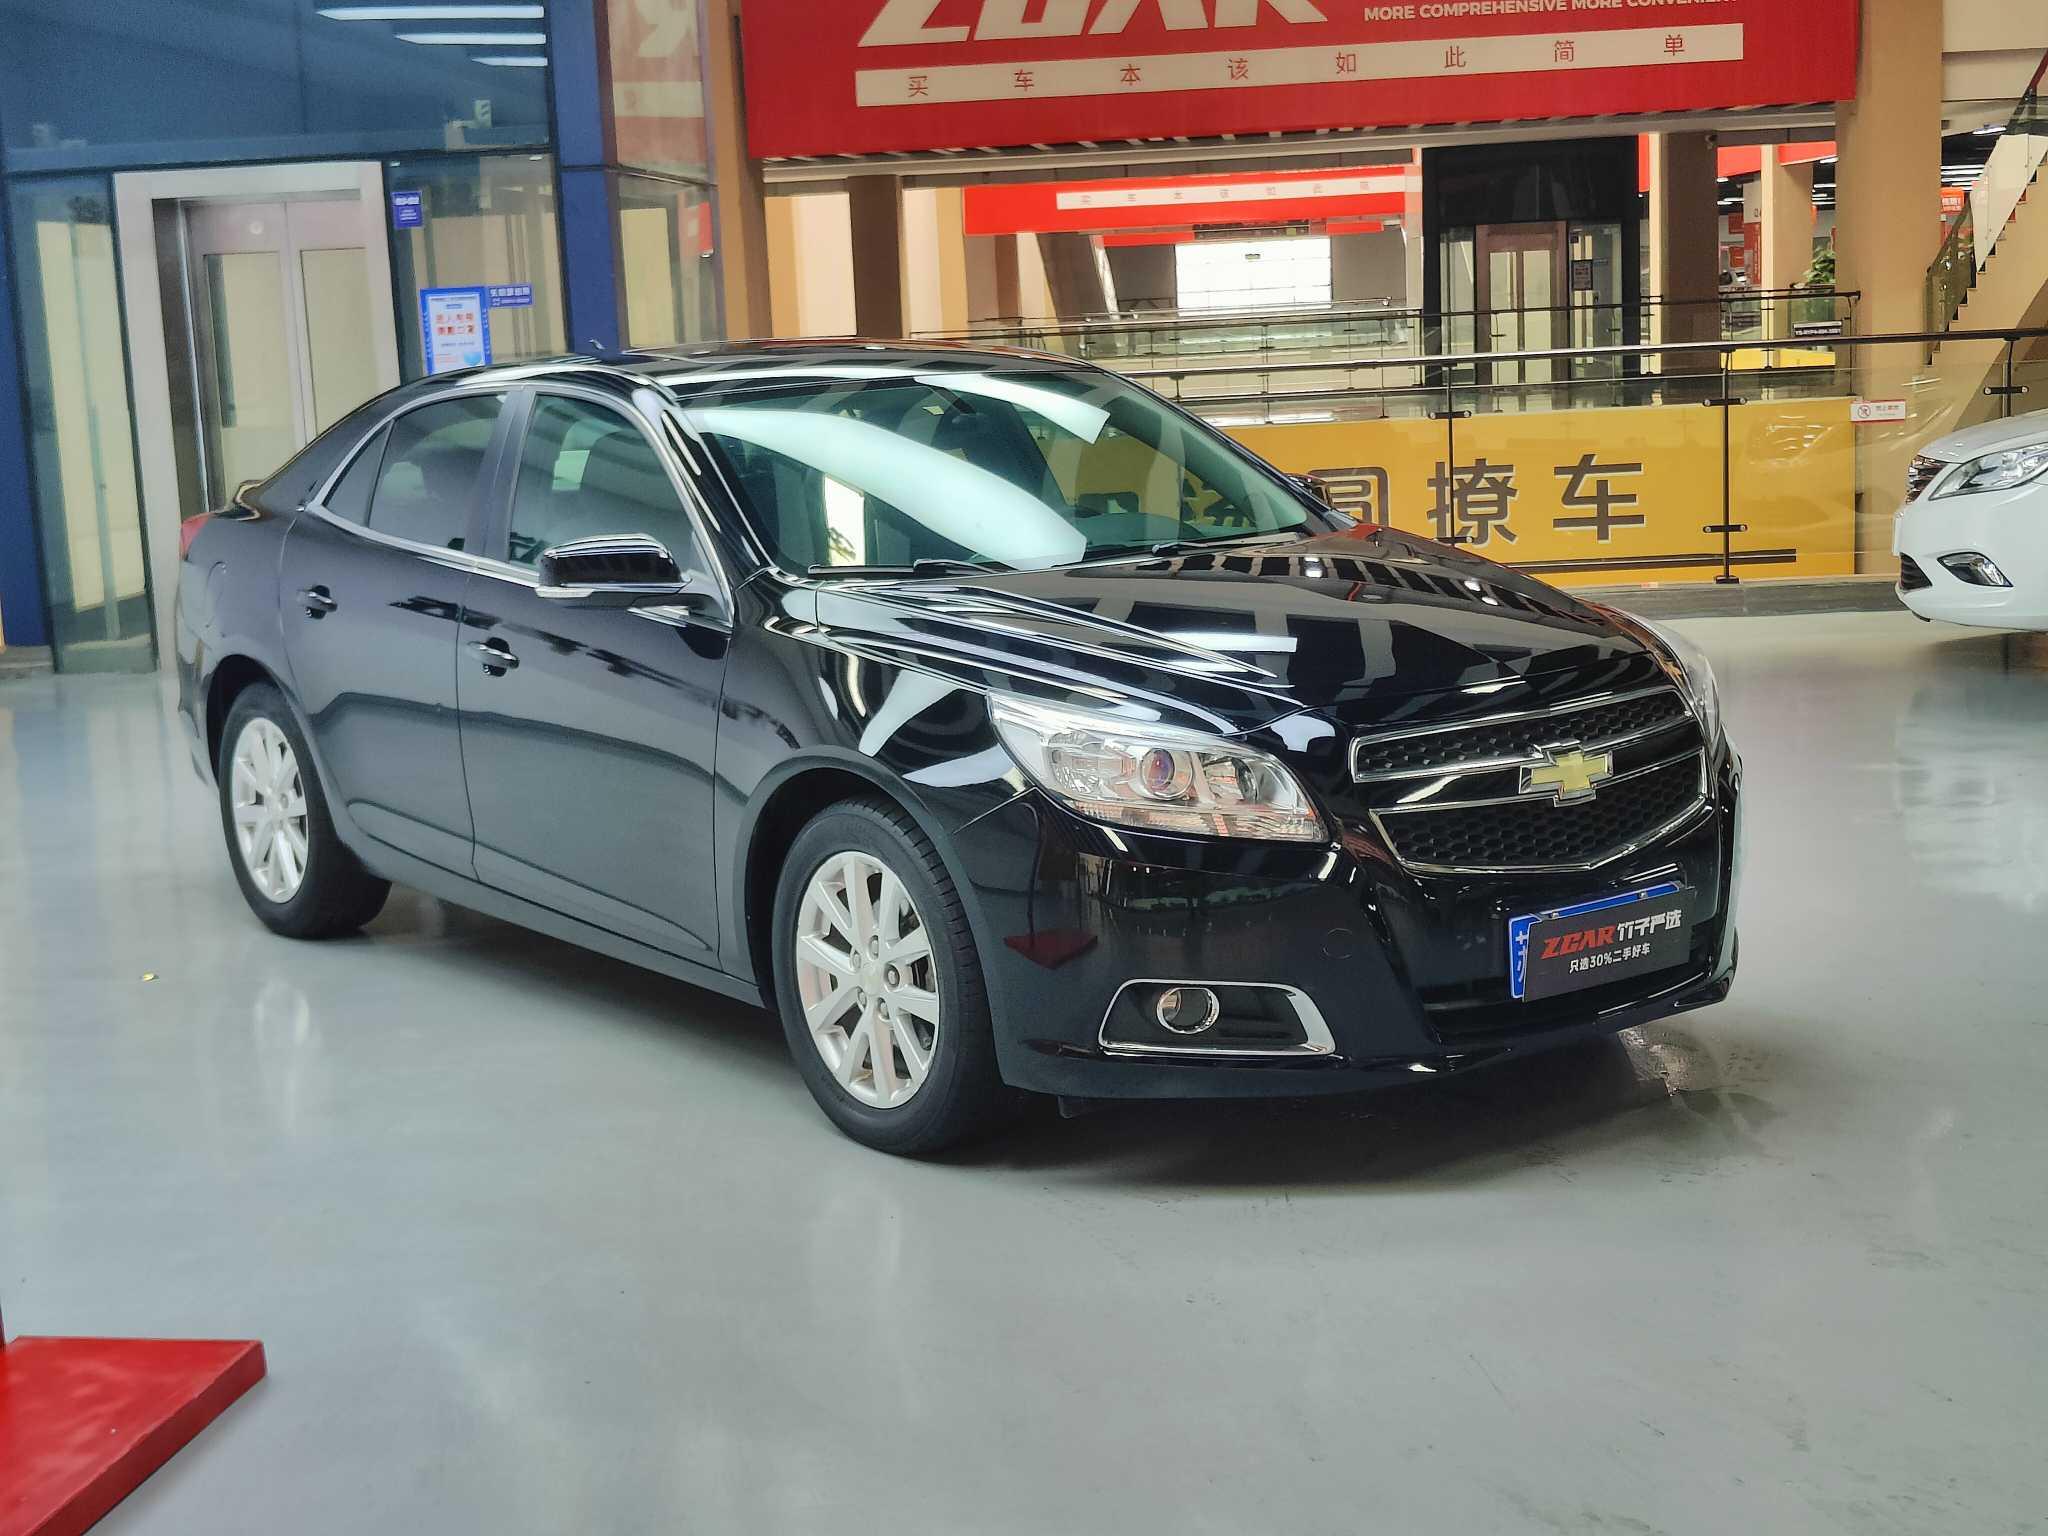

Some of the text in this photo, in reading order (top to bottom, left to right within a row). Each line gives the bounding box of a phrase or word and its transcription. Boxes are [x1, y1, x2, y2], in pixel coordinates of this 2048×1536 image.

[1364, 5, 1416, 21] MORE
[1419, 0, 1567, 18] COMPREHENSIVE
[908, 34, 1686, 97] 买车本该如此简单
[1541, 925, 1617, 960] ZCAR
[1617, 909, 1682, 942] 竹子严选
[1569, 942, 1651, 974] 只选30%二手好车
